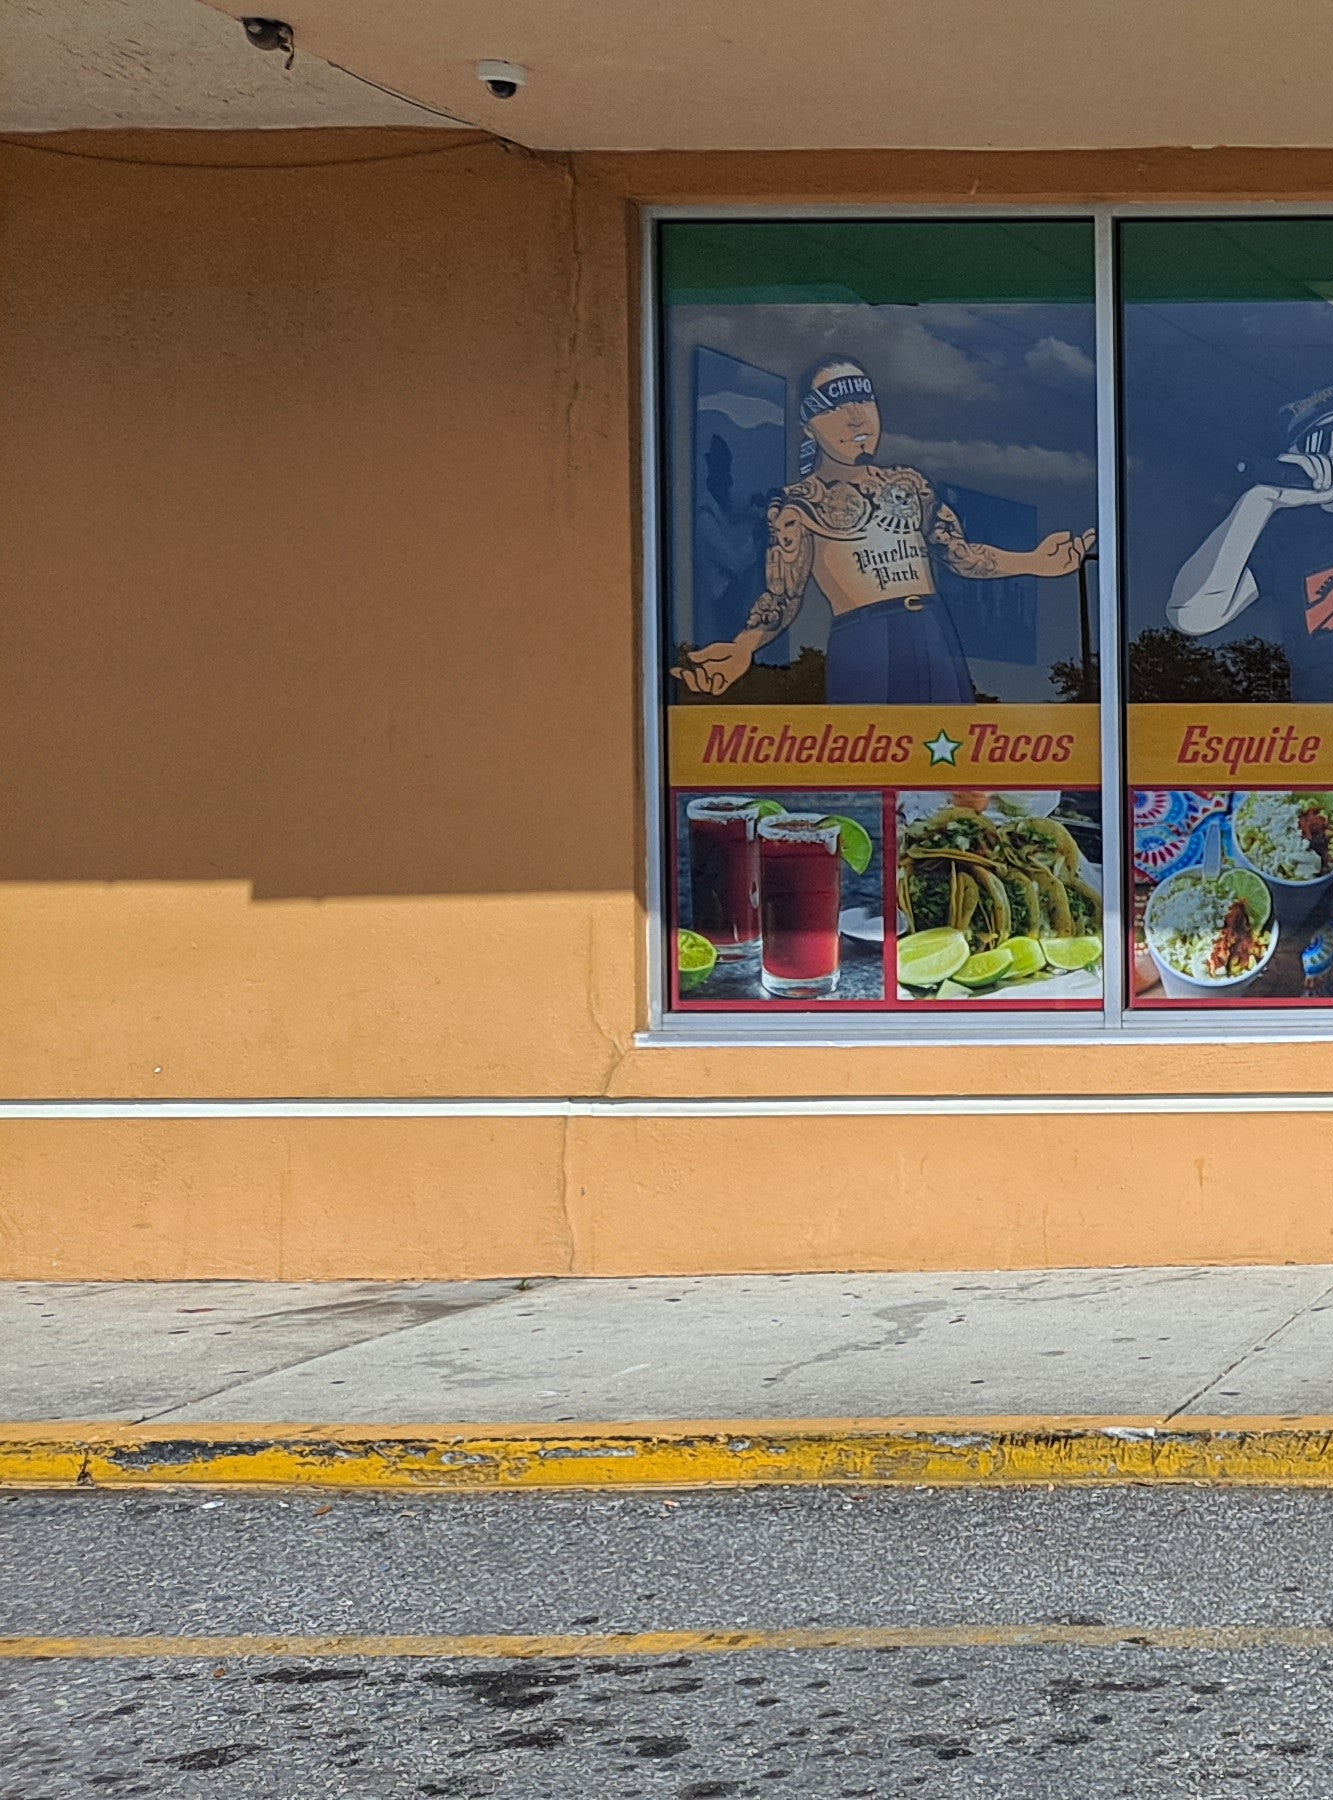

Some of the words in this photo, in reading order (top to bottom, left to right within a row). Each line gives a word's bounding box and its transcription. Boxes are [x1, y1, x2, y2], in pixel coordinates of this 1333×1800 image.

[853, 540, 929, 573] Pinellas
[873, 563, 919, 590] Park
[702, 724, 914, 764] Micheladas
[968, 723, 1075, 763] Tacos
[1177, 725, 1322, 775] Esquite
